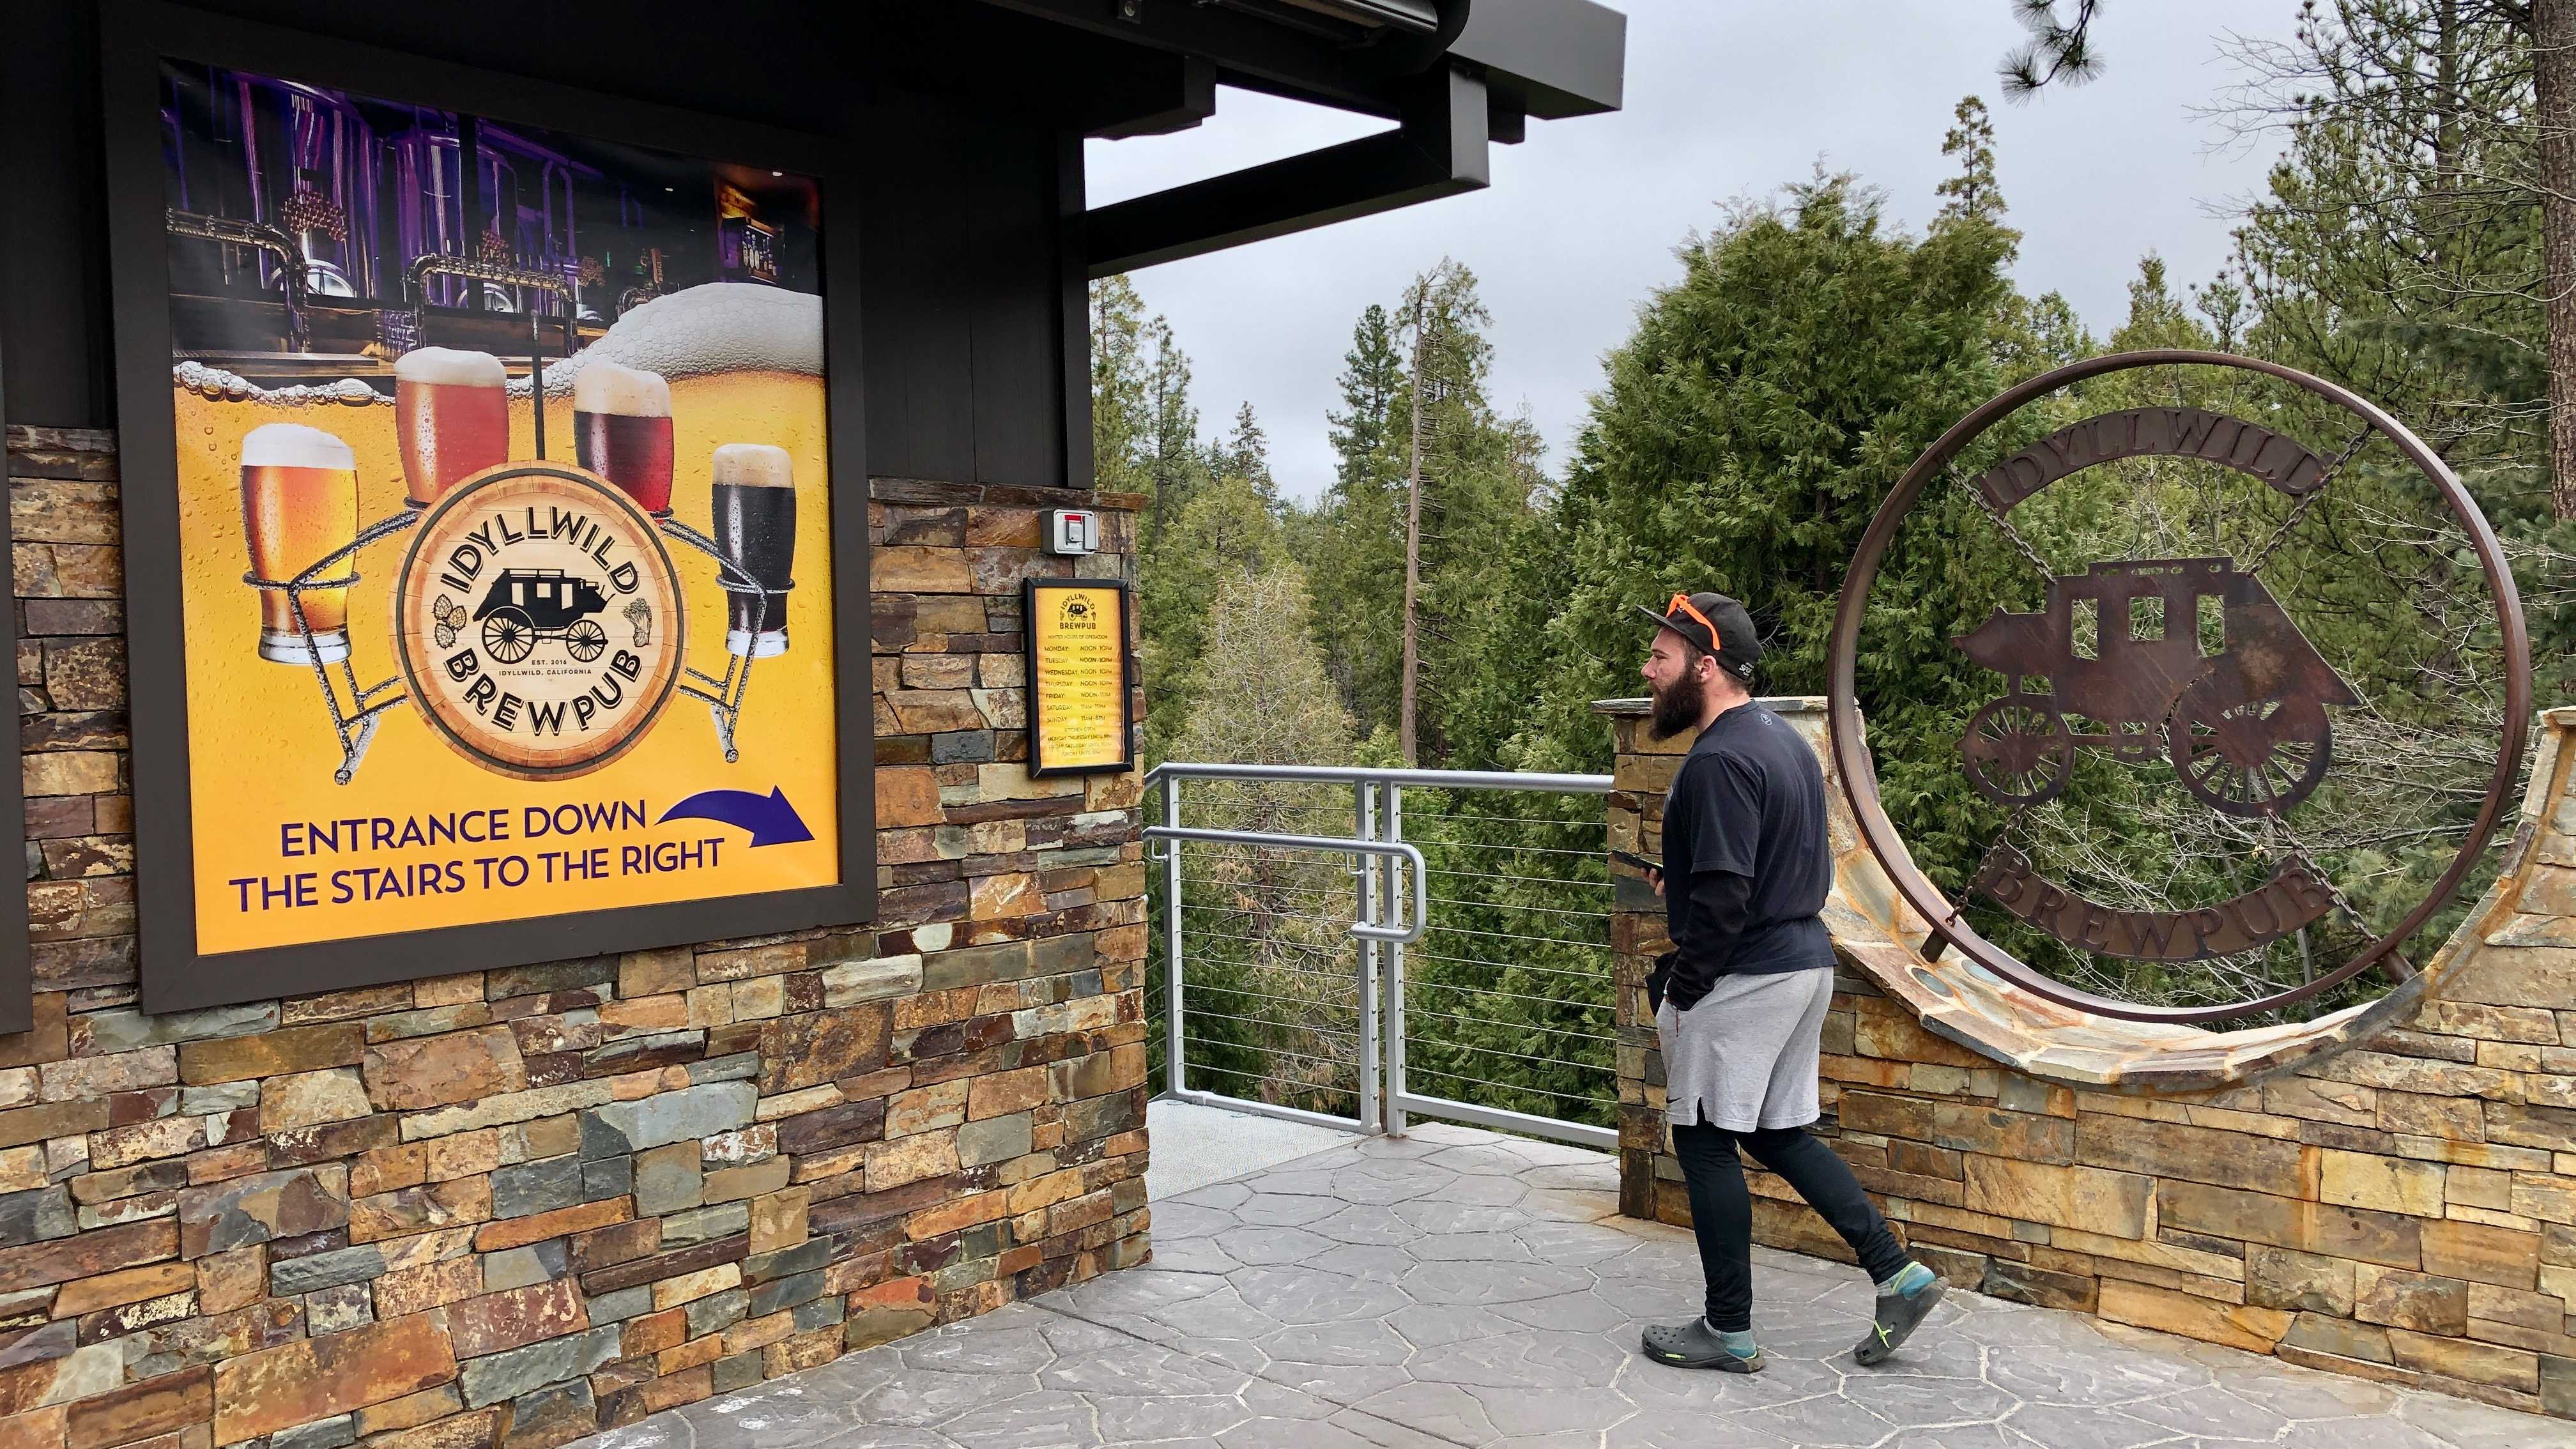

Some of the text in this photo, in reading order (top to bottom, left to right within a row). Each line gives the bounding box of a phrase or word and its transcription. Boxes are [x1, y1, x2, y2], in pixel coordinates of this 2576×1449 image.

[1981, 408, 2331, 509] IDYLLWILD
[440, 506, 640, 594] IDYLLWILD
[1061, 593, 1095, 610] IDYLLWILD
[445, 647, 643, 737] BREWPUB
[281, 800, 645, 857] ENTRANCE DOWN
[229, 838, 724, 912] THE STAIRS TO THE RIGHT
[1983, 838, 2332, 958] BREWPUB
